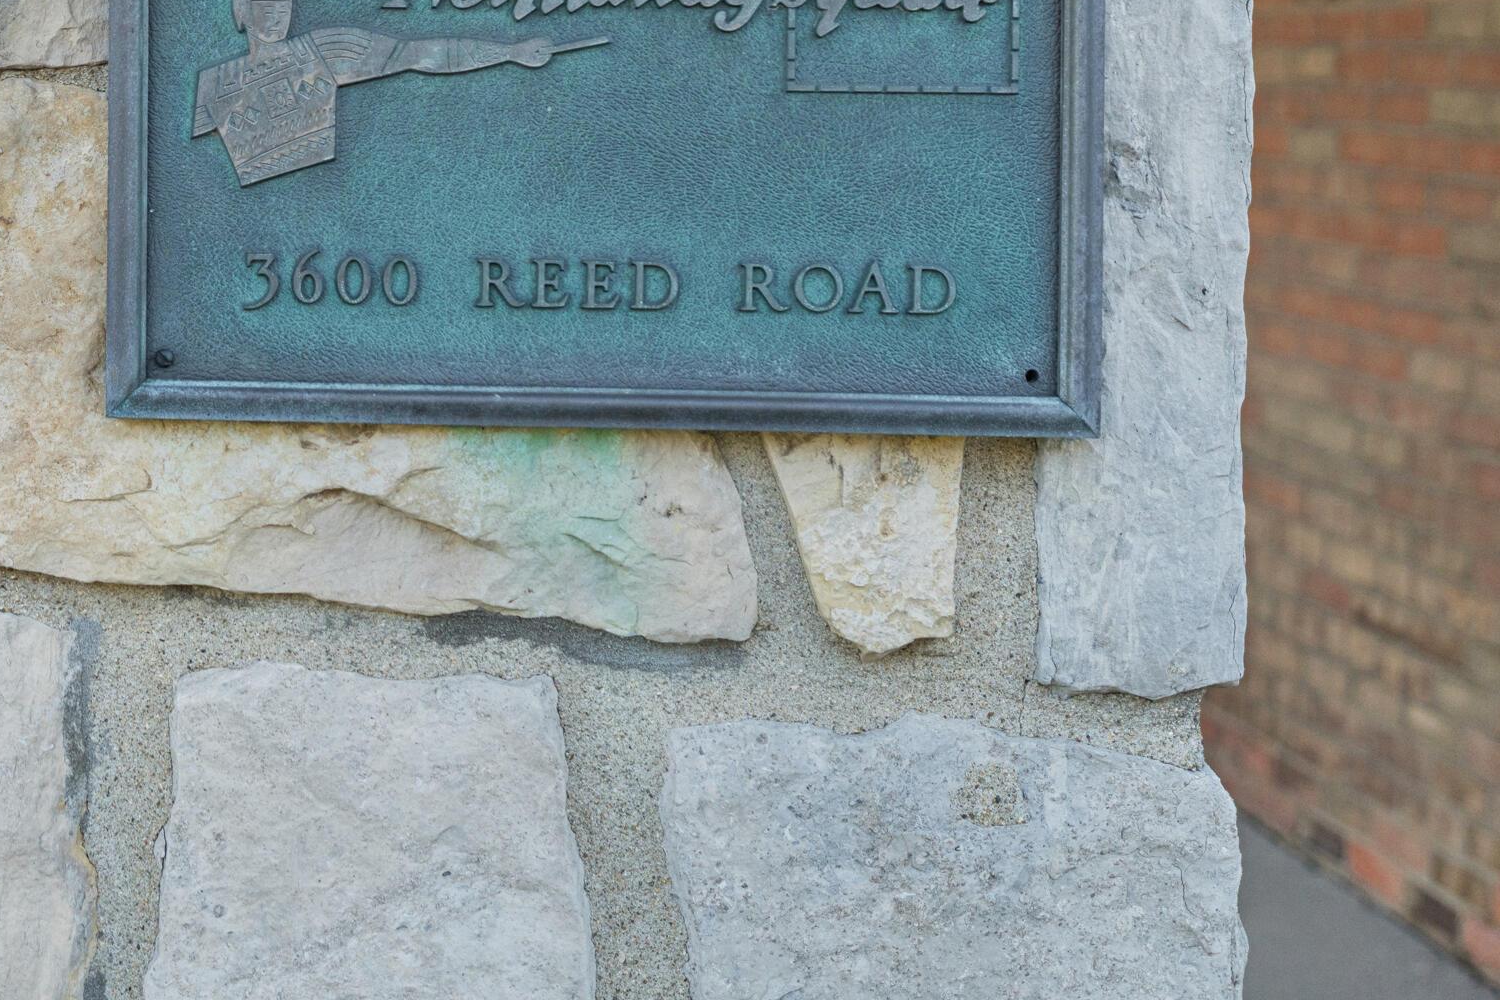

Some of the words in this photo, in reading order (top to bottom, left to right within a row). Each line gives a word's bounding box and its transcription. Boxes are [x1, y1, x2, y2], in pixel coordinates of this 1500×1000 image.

[243, 248, 418, 311] 3600
[474, 256, 680, 311] REED
[736, 260, 958, 315] ROAD
